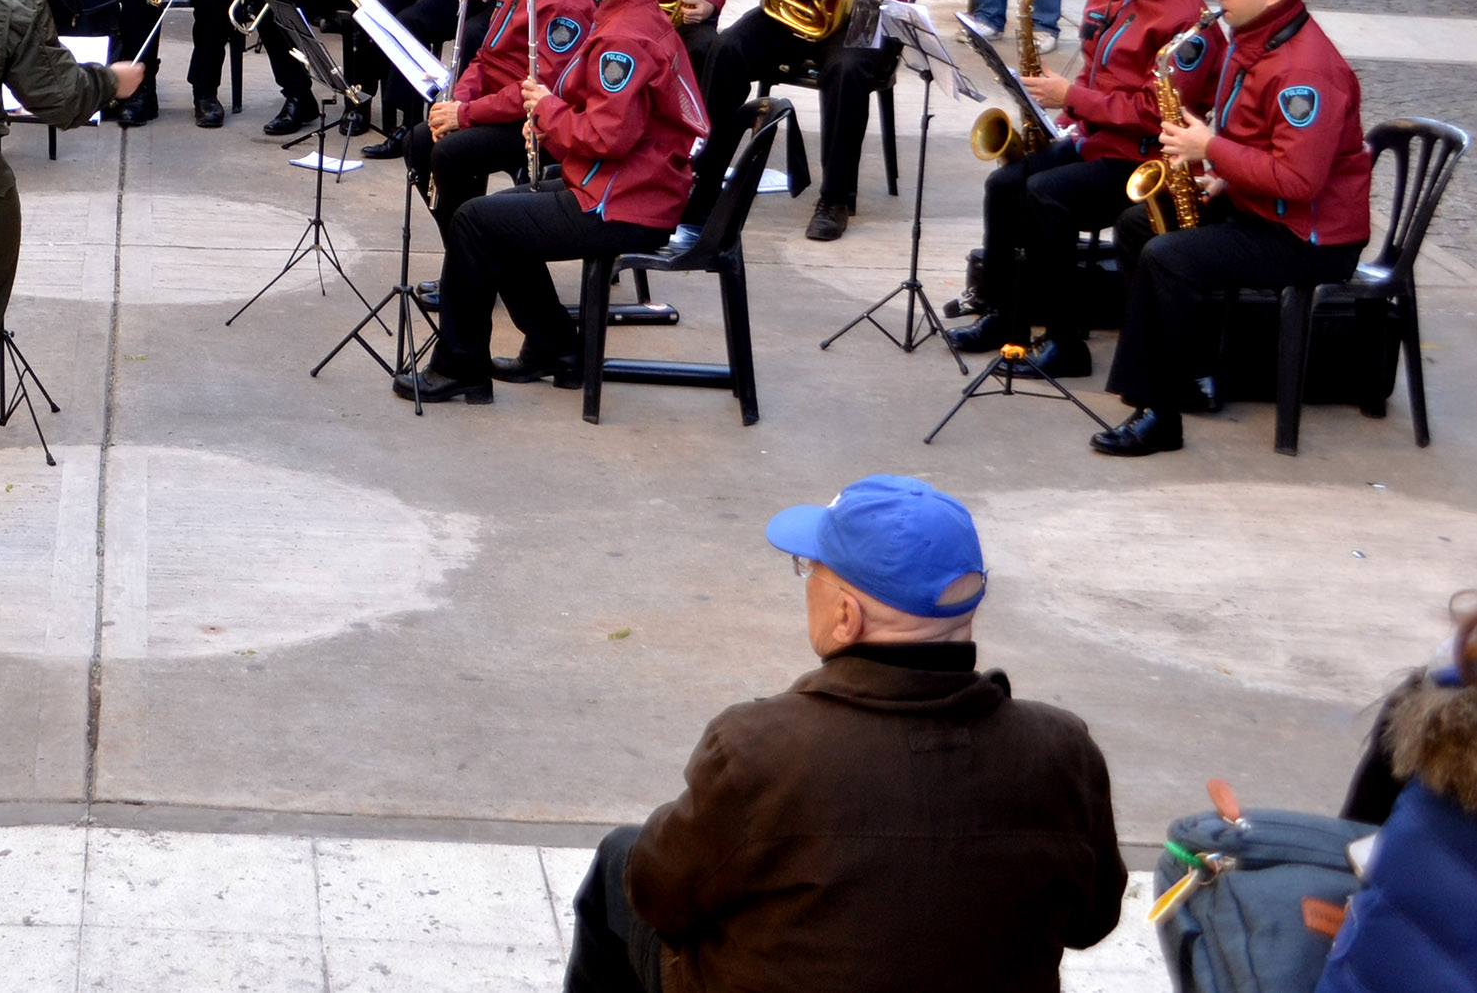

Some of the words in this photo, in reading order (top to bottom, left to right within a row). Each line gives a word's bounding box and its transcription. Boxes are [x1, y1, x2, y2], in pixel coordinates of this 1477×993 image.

[556, 18, 575, 30] POLICIA
[606, 54, 627, 64] POLICIA
[1285, 89, 1309, 97] POLICIA
